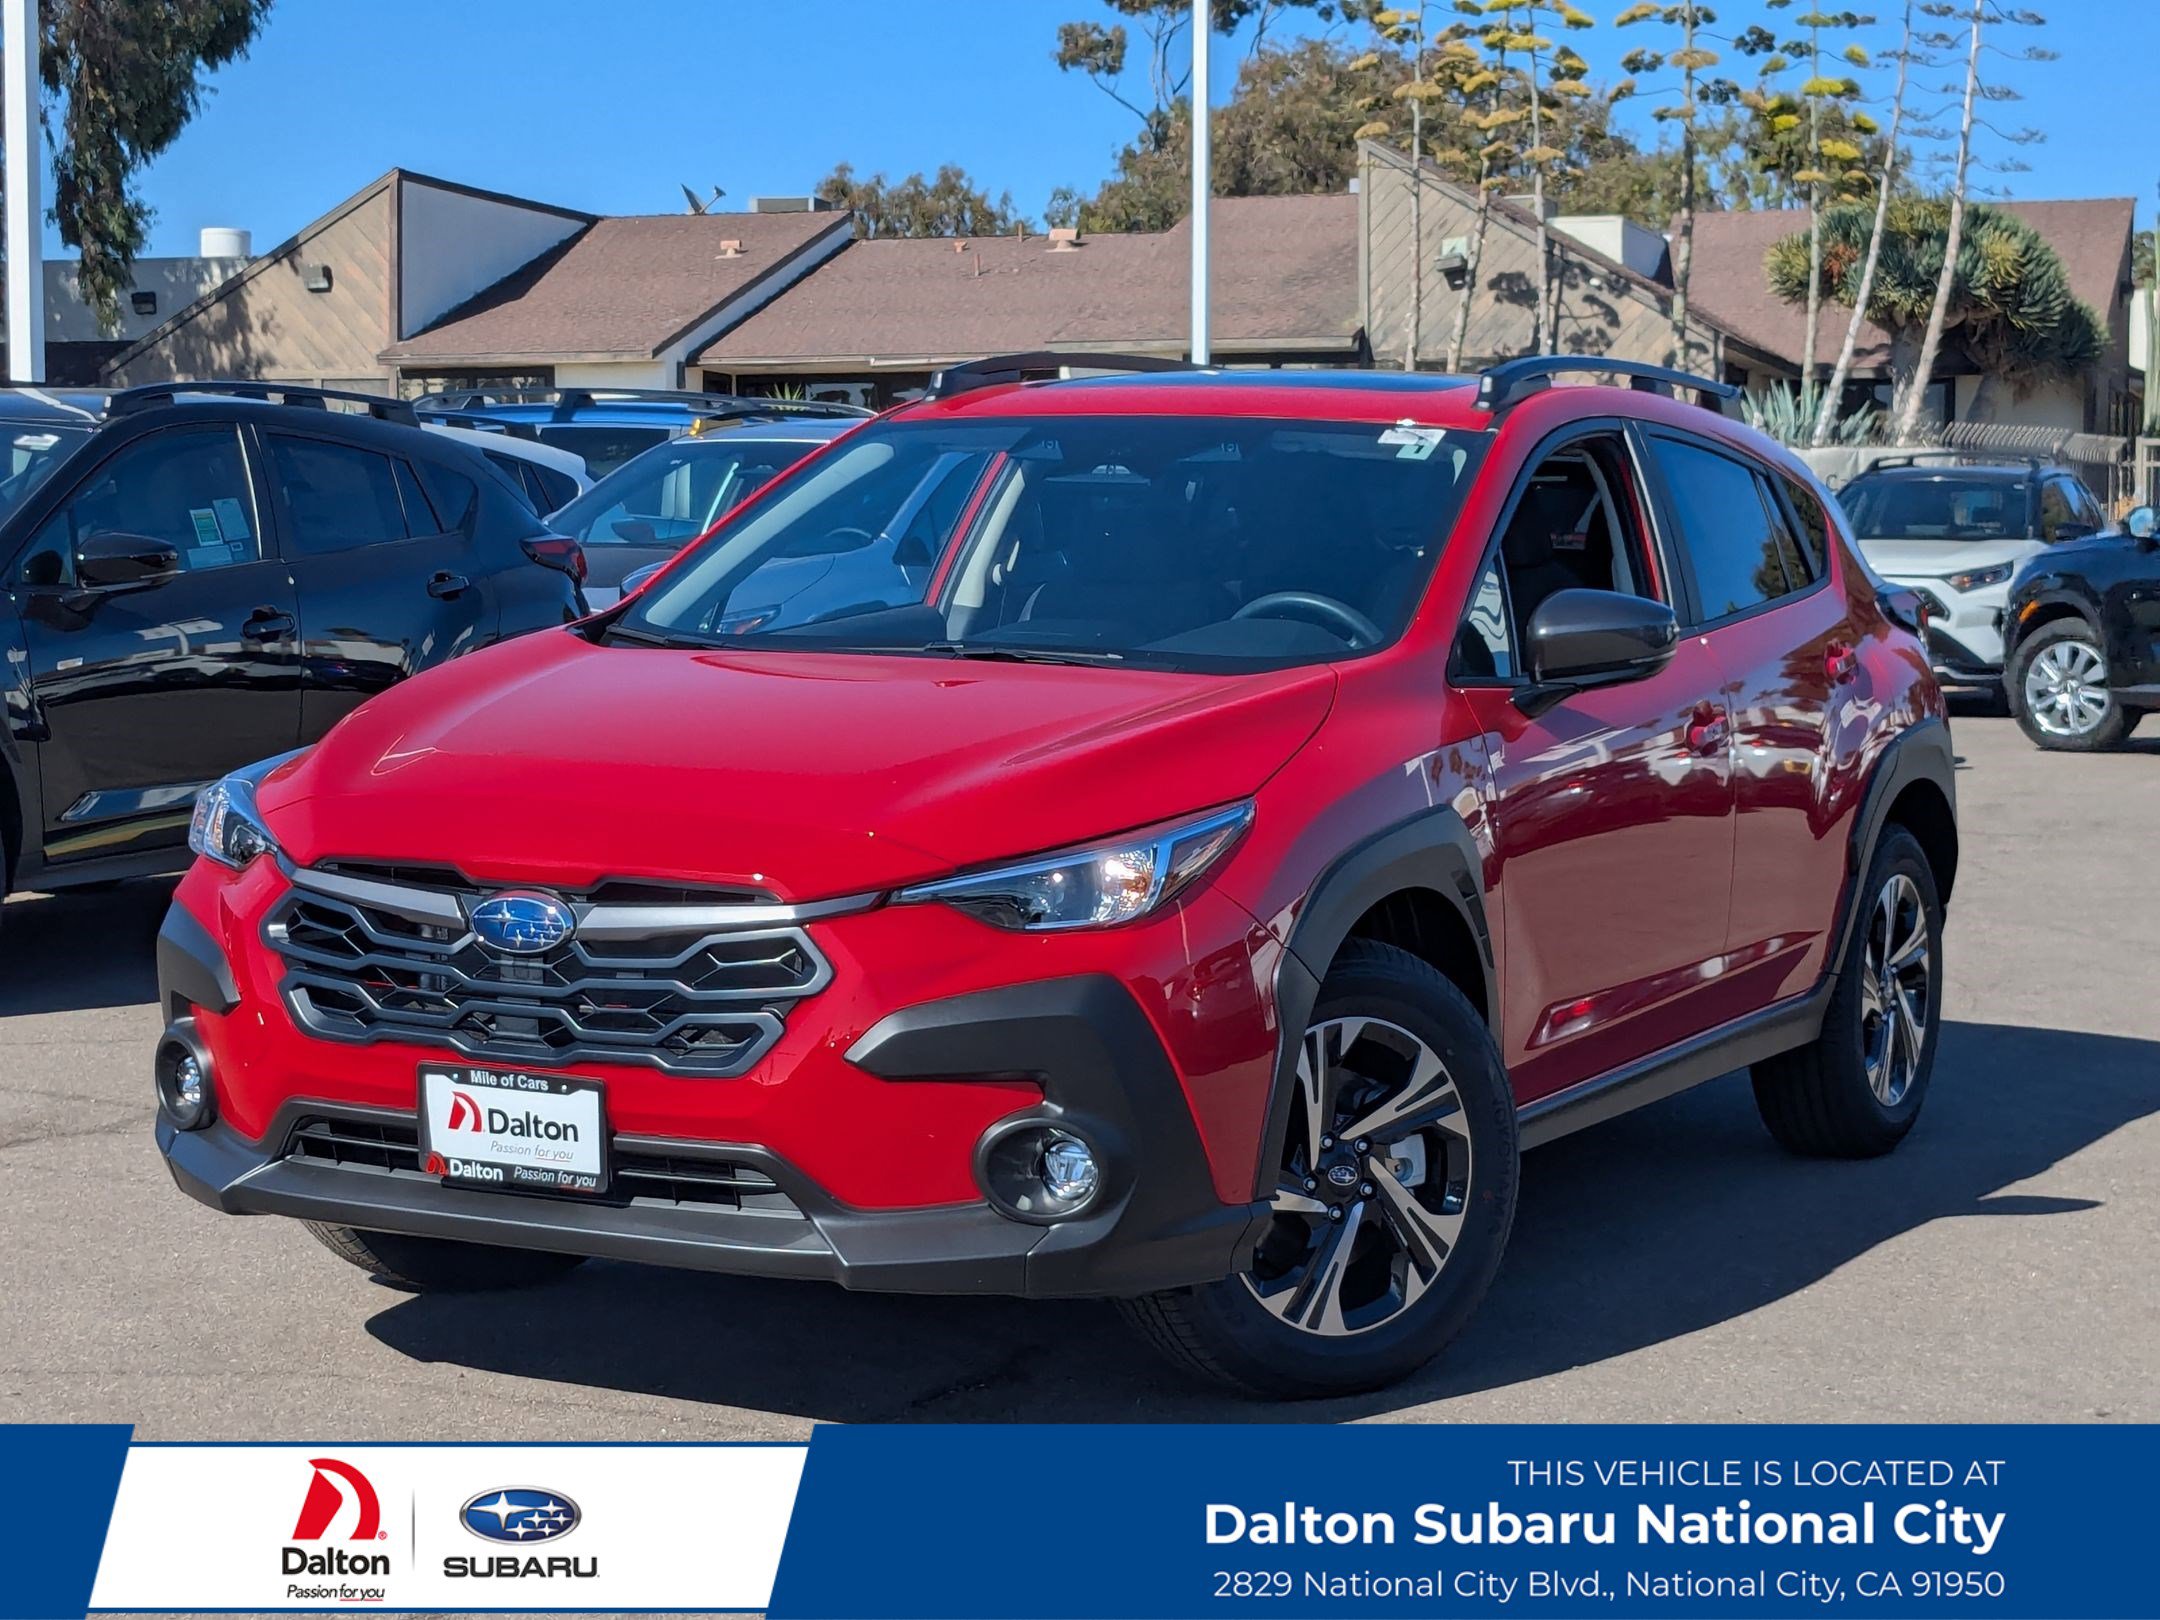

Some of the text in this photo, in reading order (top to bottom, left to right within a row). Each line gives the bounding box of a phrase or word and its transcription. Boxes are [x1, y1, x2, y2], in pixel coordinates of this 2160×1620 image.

[470, 1070, 549, 1091] Mile of Cars
[488, 1108, 579, 1142] Dalton
[490, 1140, 574, 1161] Passion for you
[450, 1159, 504, 1181] Dalton
[514, 1166, 597, 1189] Passion for you
